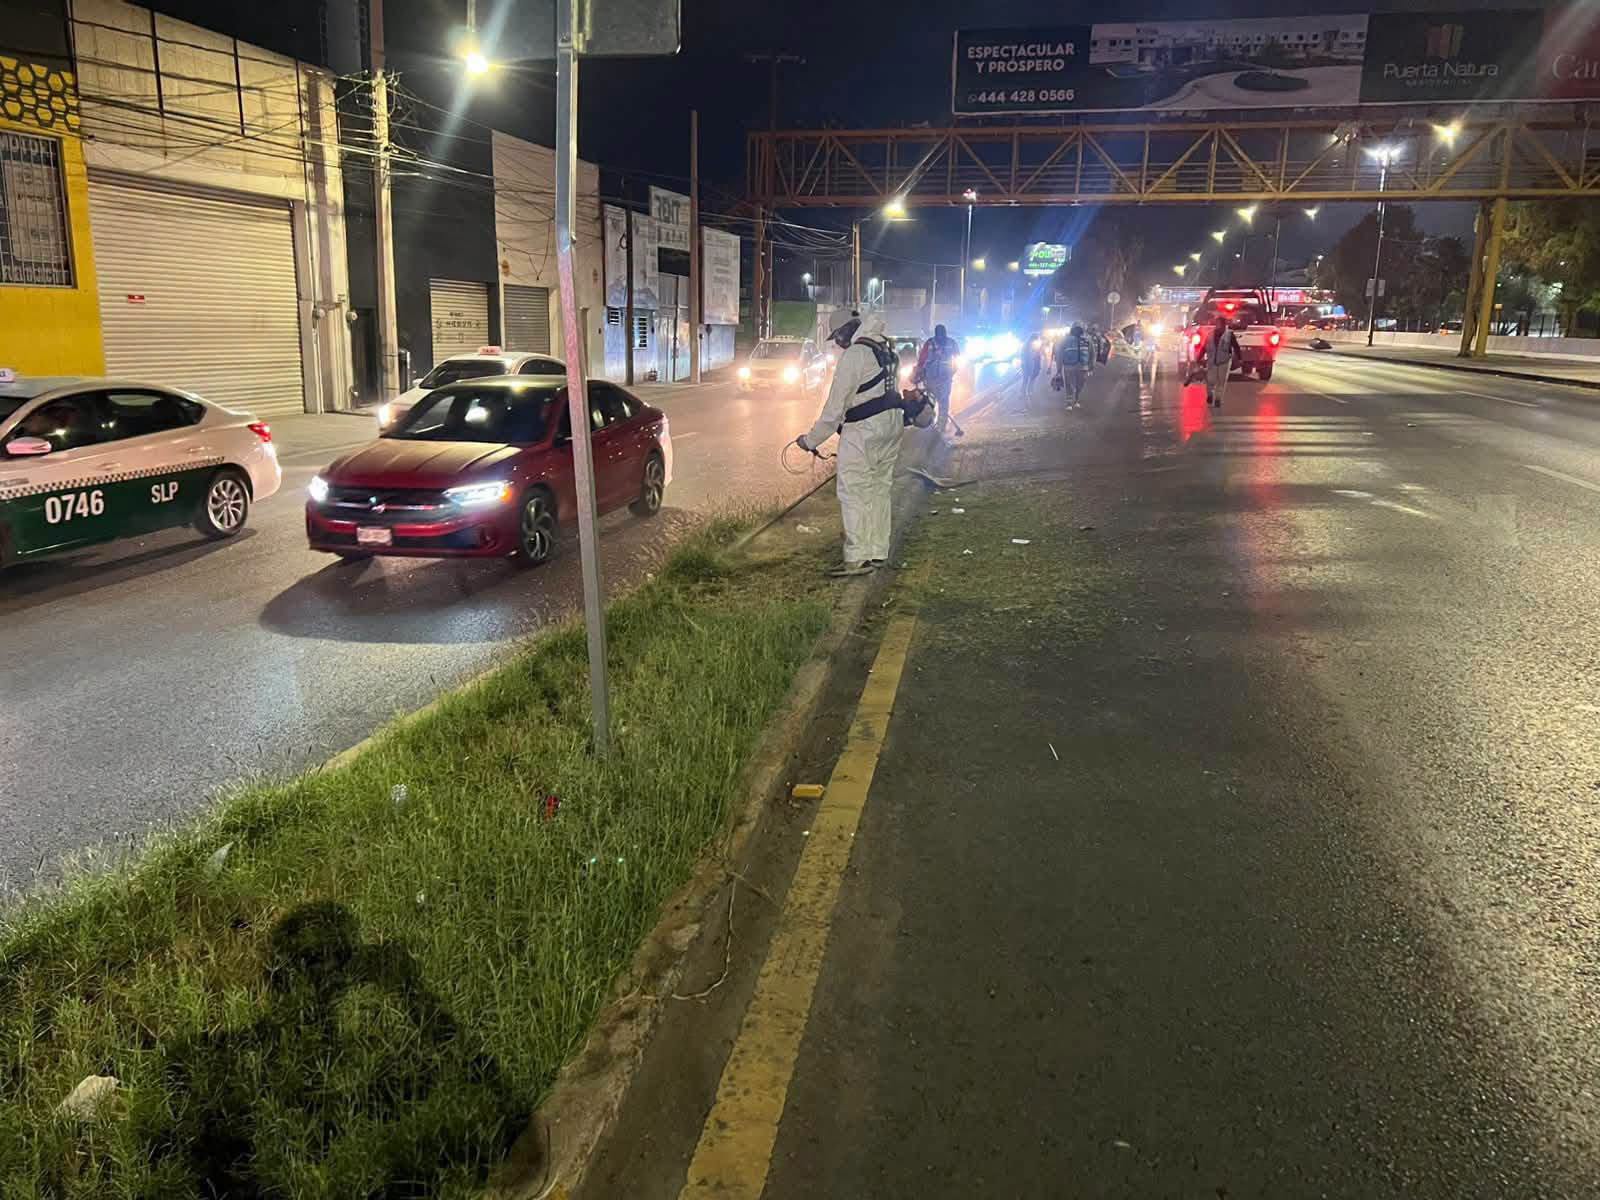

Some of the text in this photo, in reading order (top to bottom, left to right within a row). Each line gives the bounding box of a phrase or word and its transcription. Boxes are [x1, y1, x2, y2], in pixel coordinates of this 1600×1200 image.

[967, 43, 1075, 59] ESPECTACULAR
[975, 61, 985, 74] Y
[1383, 62, 1499, 79] Puerta Natura
[978, 91, 1006, 104] 444
[1010, 90, 1036, 103] 428
[151, 481, 180, 504] SLP
[44, 490, 105, 524] 0746
